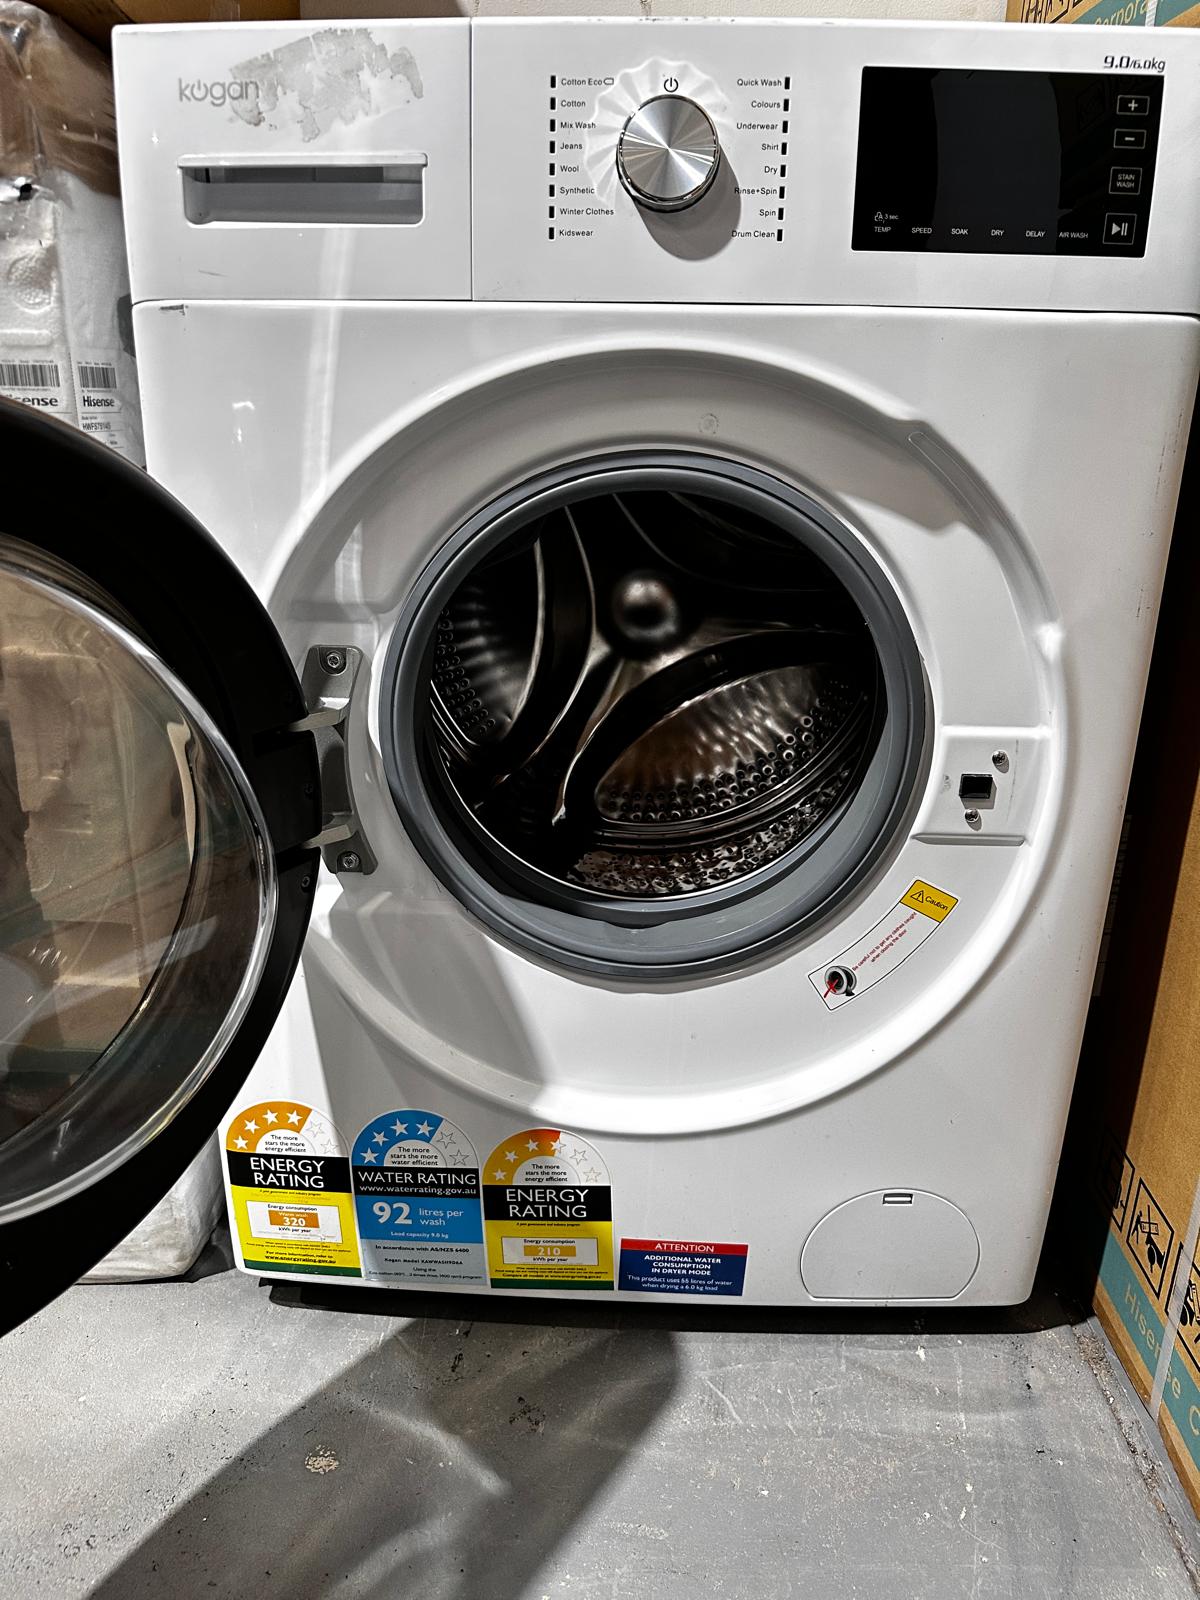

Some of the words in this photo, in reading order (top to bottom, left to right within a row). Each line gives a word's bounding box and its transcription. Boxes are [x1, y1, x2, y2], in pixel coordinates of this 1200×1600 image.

[1103, 56, 1166, 73] 9.0/6.0kg
[561, 78, 586, 86] Cotton
[588, 78, 602, 86] Eco
[737, 78, 758, 87] Quick
[760, 79, 782, 87] Wash
[178, 77, 259, 107] kogan
[561, 100, 586, 108] Cotton
[751, 100, 781, 108] Colours
[560, 142, 583, 150] Jeans
[761, 143, 779, 151] Shirt
[560, 165, 579, 173] Wool
[764, 166, 778, 175] Dry
[560, 187, 595, 196] Synthetic
[586, 208, 614, 216] Clothes
[759, 208, 776, 218] Spin
[559, 229, 593, 237] Kidswear
[731, 230, 752, 238] Drum
[753, 230, 775, 238] Clean
[1025, 230, 1045, 238] DELAY
[14, 396, 58, 407] ense
[82, 395, 115, 407] Hisense
[925, 896, 948, 910] Caution
[250, 1157, 324, 1173] ENERGY
[254, 1172, 324, 1188] RATING
[358, 1171, 414, 1184] WATER
[418, 1173, 476, 1185] RATING
[360, 1186, 476, 1195] www.waterrating.gov.au
[506, 1189, 589, 1202] ENERGY
[372, 1201, 412, 1225] 92
[419, 1208, 444, 1217] litres
[447, 1210, 464, 1218] per
[509, 1205, 587, 1218] RATING
[283, 1217, 306, 1227] 320
[420, 1218, 446, 1226] wash
[538, 1247, 560, 1256] 210
[655, 1242, 715, 1253] ATTENTION
